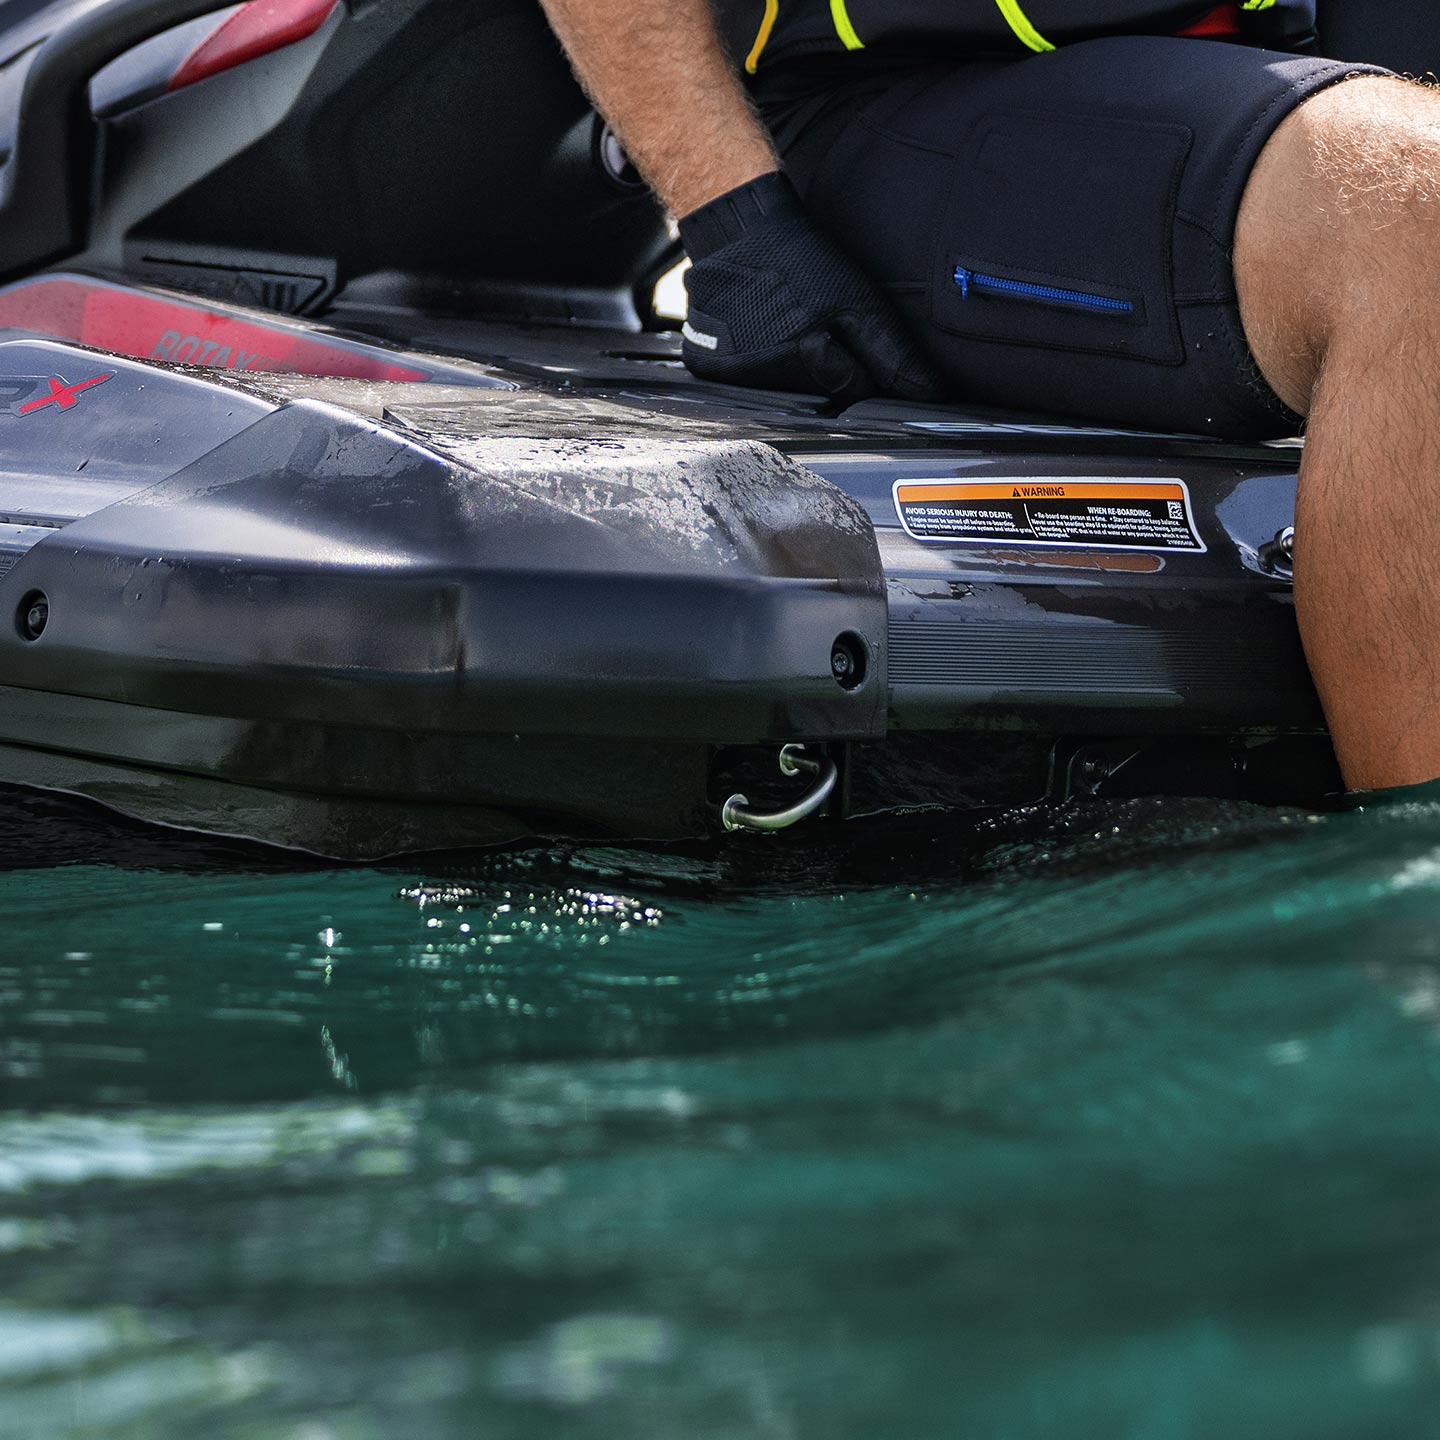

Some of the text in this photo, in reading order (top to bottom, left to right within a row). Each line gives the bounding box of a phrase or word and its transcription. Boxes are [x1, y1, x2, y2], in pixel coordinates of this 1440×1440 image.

[150, 329, 257, 369] ROTAX
[1021, 486, 1065, 497] WARNING
[954, 509, 977, 517] INJURY
[1087, 506, 1151, 517] WHEN RE-BOARDING:
